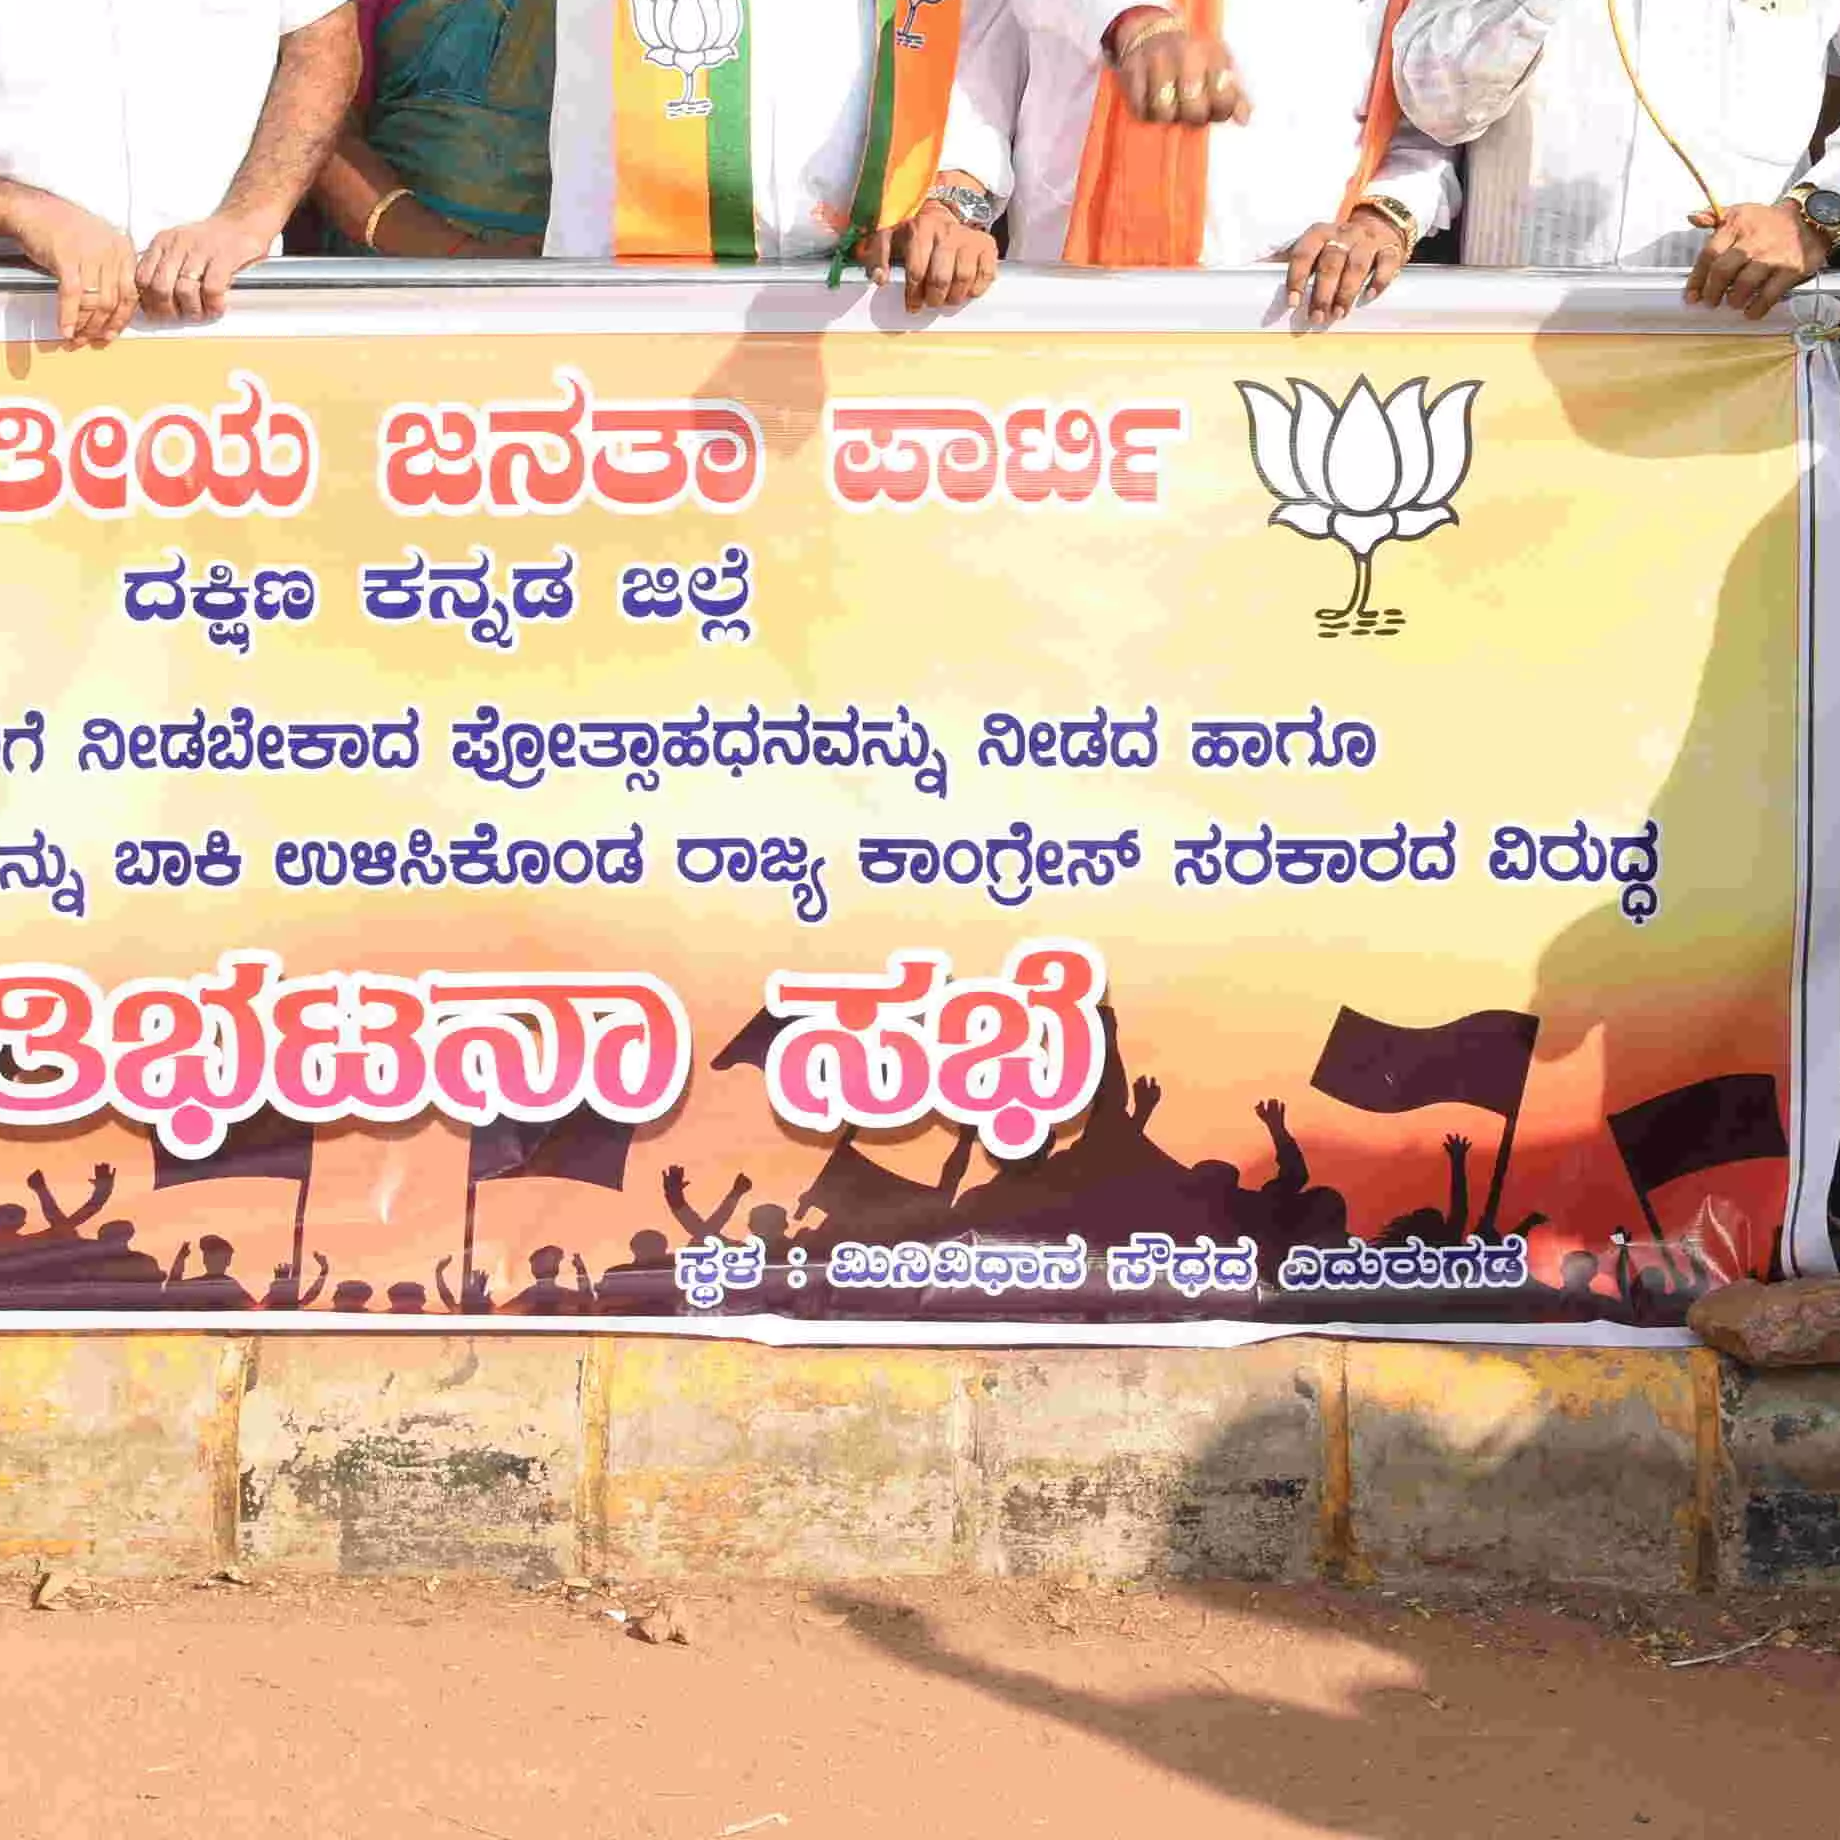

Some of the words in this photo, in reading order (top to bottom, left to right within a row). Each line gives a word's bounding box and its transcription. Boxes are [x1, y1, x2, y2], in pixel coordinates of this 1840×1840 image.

[384, 374, 762, 508] ಜನತಾ
[830, 406, 1182, 505] ಪಾರ್ಟಿ
[123, 550, 317, 654] ದಕ್ಷಿಣ
[362, 548, 573, 649] ಕನ್ನಡ
[621, 546, 751, 642] ಜಿಲ್ಲೆ
[78, 705, 420, 773] ನೀಡಬೇಕಾದ
[977, 705, 1159, 770] ನೀಡದ
[1190, 705, 1379, 769] ಹಾಗೂ
[114, 829, 242, 887] ಬಾಕಿ
[274, 821, 645, 887] ಉಳಿಸಿಕೊಂಡ
[676, 835, 829, 924] ರಾಜ್ಯ
[859, 821, 1143, 907] ಕಾಂಗ್ರೇಸ್
[1173, 819, 1457, 888] ಸರಕಾರದ
[1488, 818, 1659, 926] ವಿರುದ್ಧ
[771, 948, 1106, 1147] ಸಭೆ
[676, 1237, 765, 1307] ಸ್ಥಳ
[828, 1233, 1087, 1295] ಮಿನಿವಿಧಾನ
[1108, 1232, 1259, 1297] ಸೌಧದ
[1279, 1234, 1528, 1290] ಎದುರುಗಡೆ
